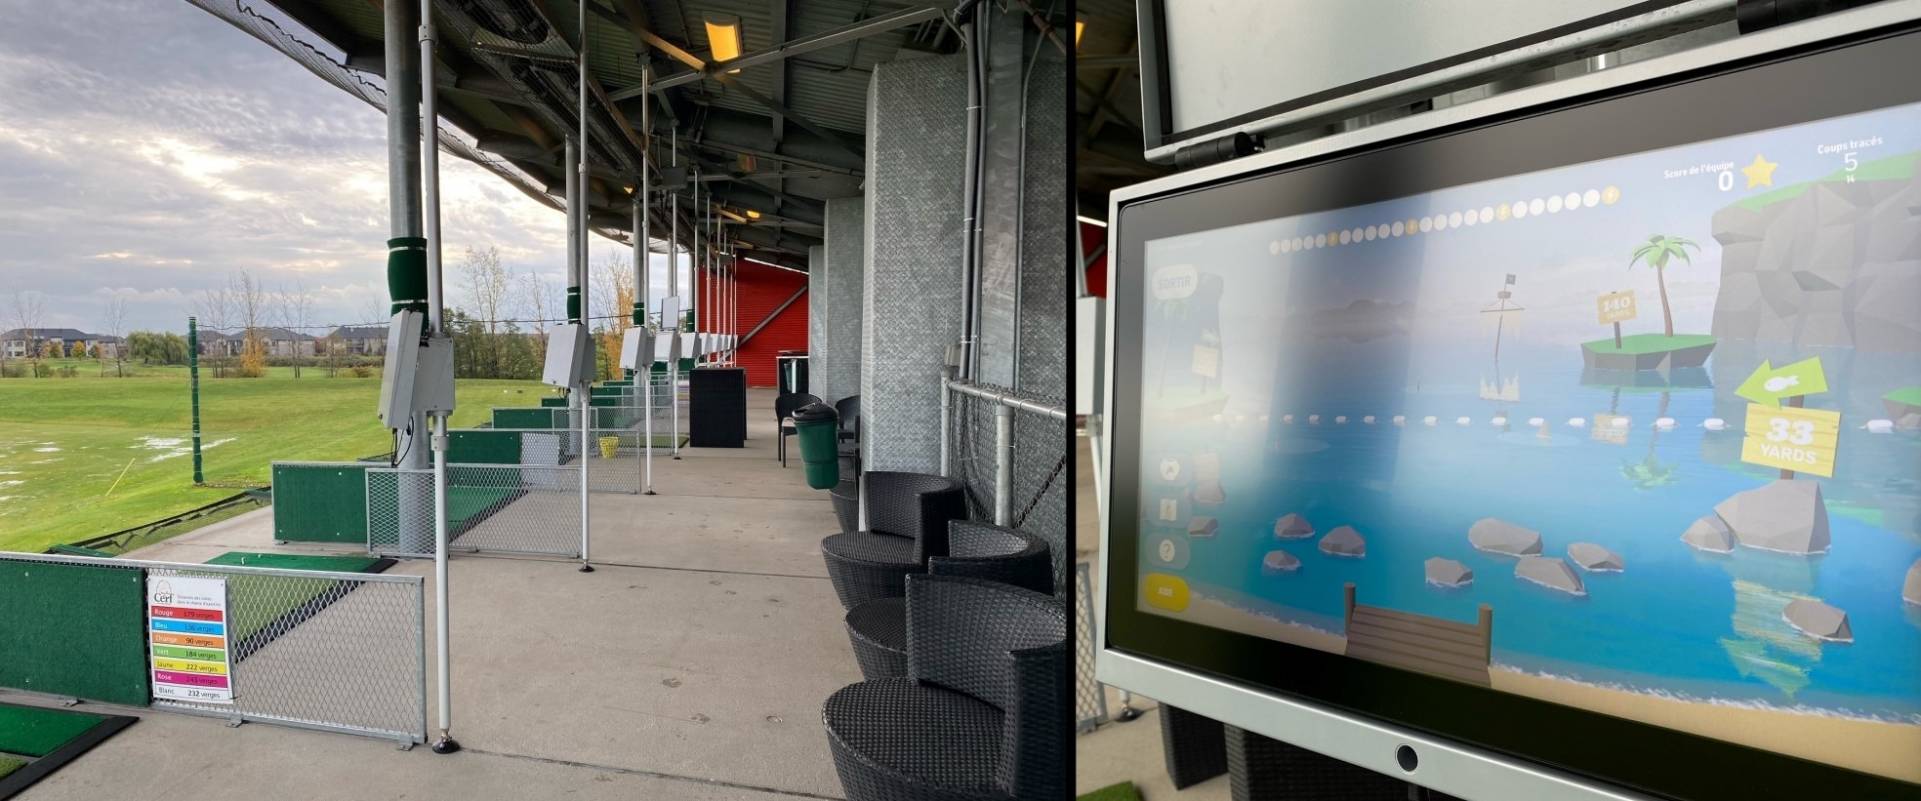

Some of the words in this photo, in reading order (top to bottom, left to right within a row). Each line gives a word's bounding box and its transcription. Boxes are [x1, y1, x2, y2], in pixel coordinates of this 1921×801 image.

[1817, 142, 1847, 155] Coups
[1849, 136, 1883, 149] tracés
[1844, 151, 1858, 172] 5
[1663, 168, 1687, 179] Score
[1689, 166, 1699, 175] de
[1718, 170, 1734, 192] 0
[1765, 416, 1815, 446] 33
[1759, 442, 1818, 465] YARDS
[154, 591, 174, 603] Cerf
[154, 608, 174, 617] Rouge
[157, 671, 172, 680] Rose
